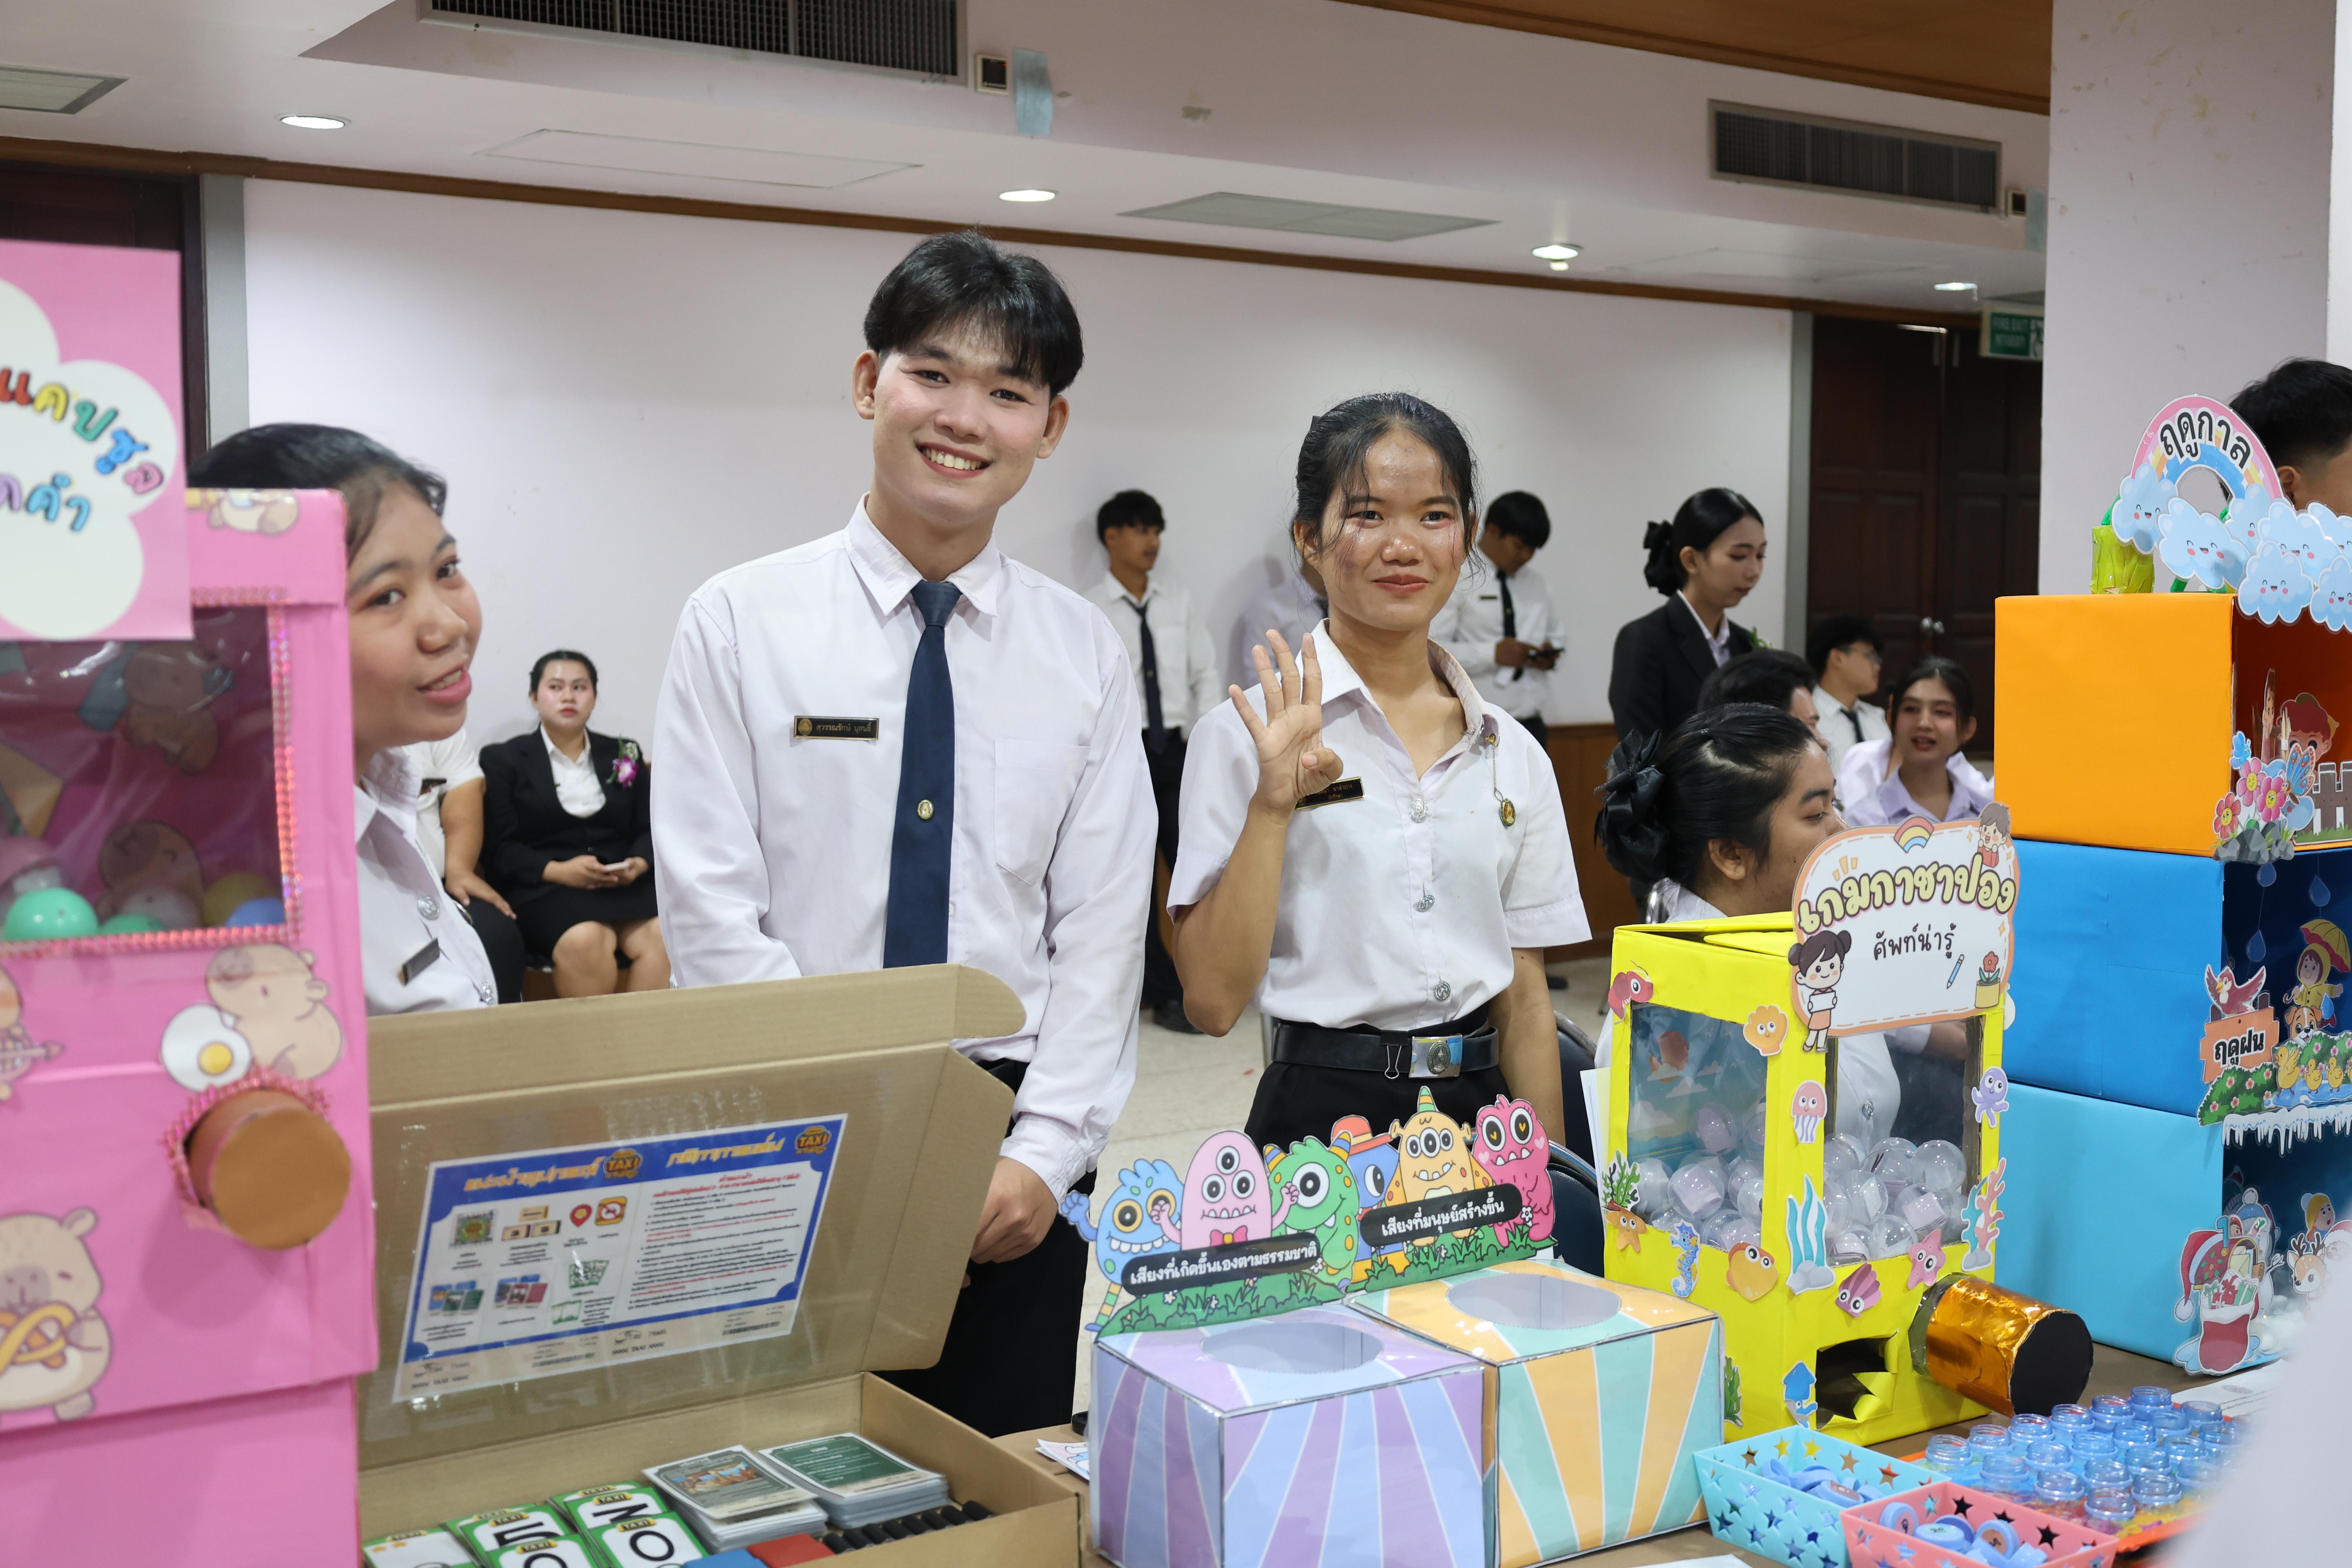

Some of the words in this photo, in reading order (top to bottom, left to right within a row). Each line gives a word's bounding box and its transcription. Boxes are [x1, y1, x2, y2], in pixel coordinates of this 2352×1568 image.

[2160, 411, 2251, 469] ฤดูกาล
[1798, 852, 2016, 935] เกมกาชาปอง
[1873, 923, 1957, 960] ศัพท์น่ารู้
[2215, 1030, 2265, 1065] ฤดูฝน
[1381, 1191, 1505, 1236] เสียงที่มนุษย์สร้างขึ้น
[1130, 1240, 1317, 1285] เสียงที่เกิดขึ้นเองตามธรรมชาติ
